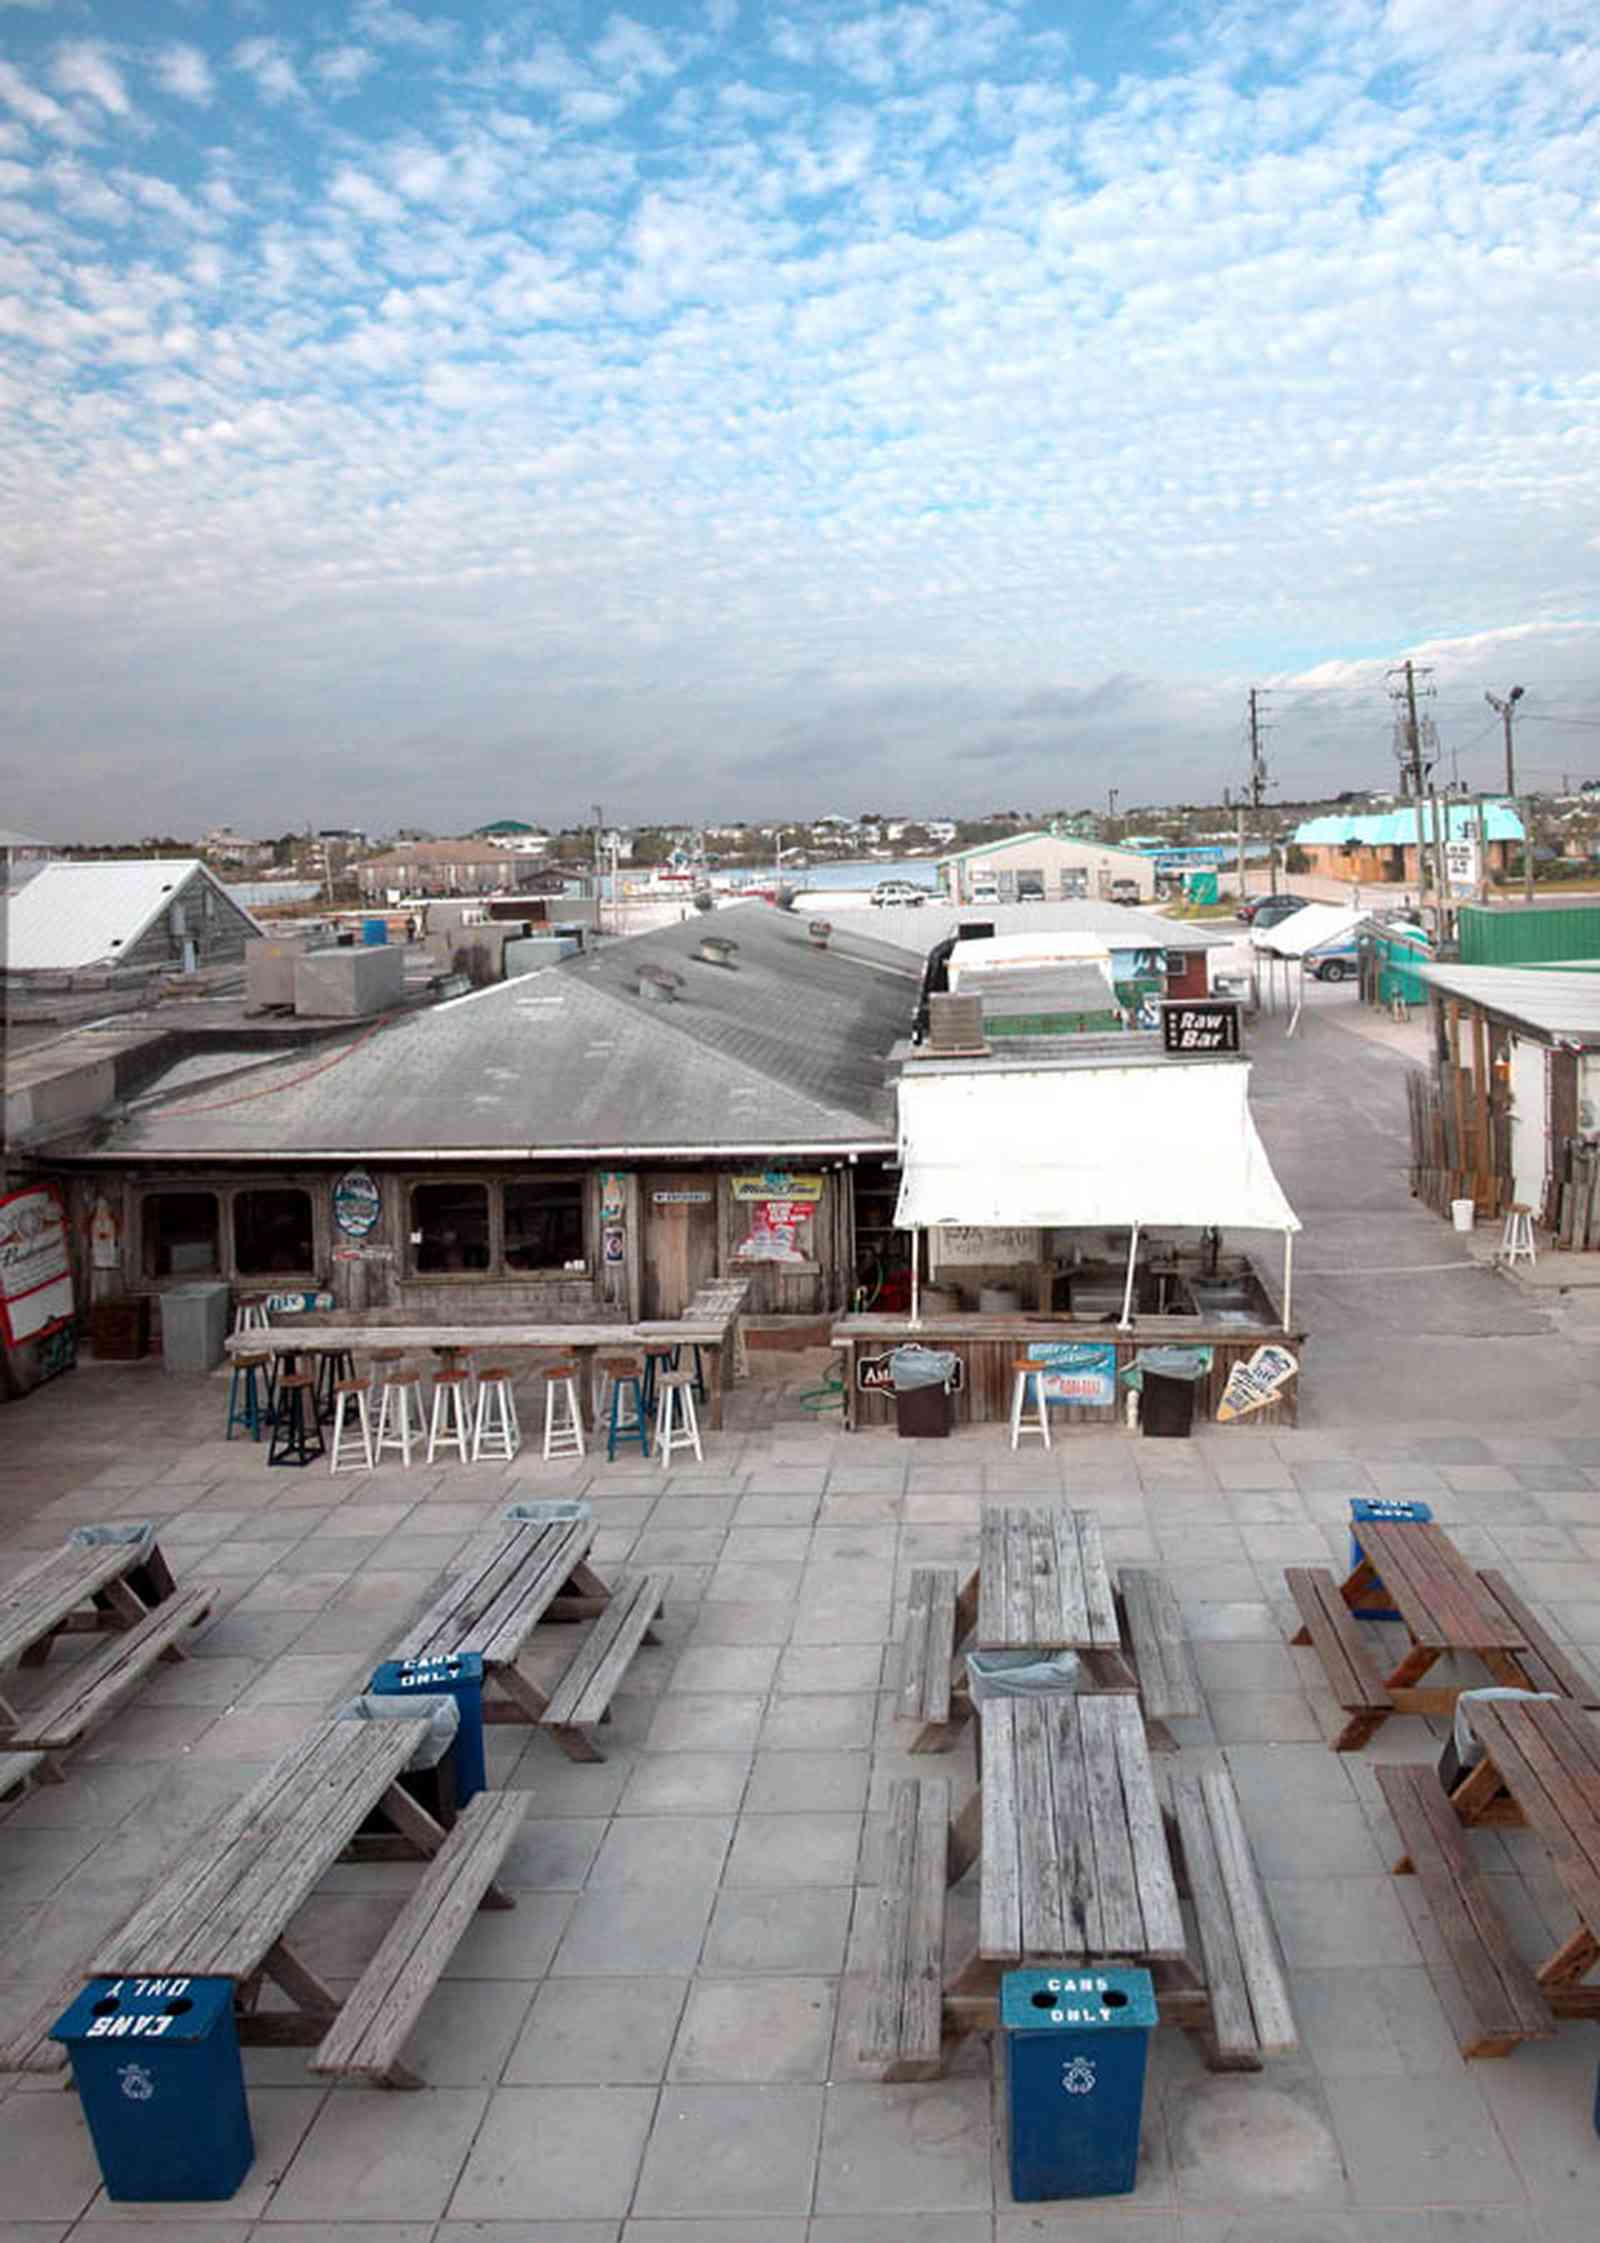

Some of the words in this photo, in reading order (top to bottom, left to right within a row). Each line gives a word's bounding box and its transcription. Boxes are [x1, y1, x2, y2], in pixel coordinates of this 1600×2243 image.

[1180, 1012, 1223, 1029] Raw
[1180, 1031, 1222, 1048] Bar
[404, 1655, 459, 1669] CANS
[401, 1669, 460, 1686] ONLY
[105, 1978, 192, 1997] ONLY
[1048, 1978, 1109, 1992] CANS
[1050, 2009, 1112, 2022] ONLY
[86, 2015, 174, 2037] CANS
